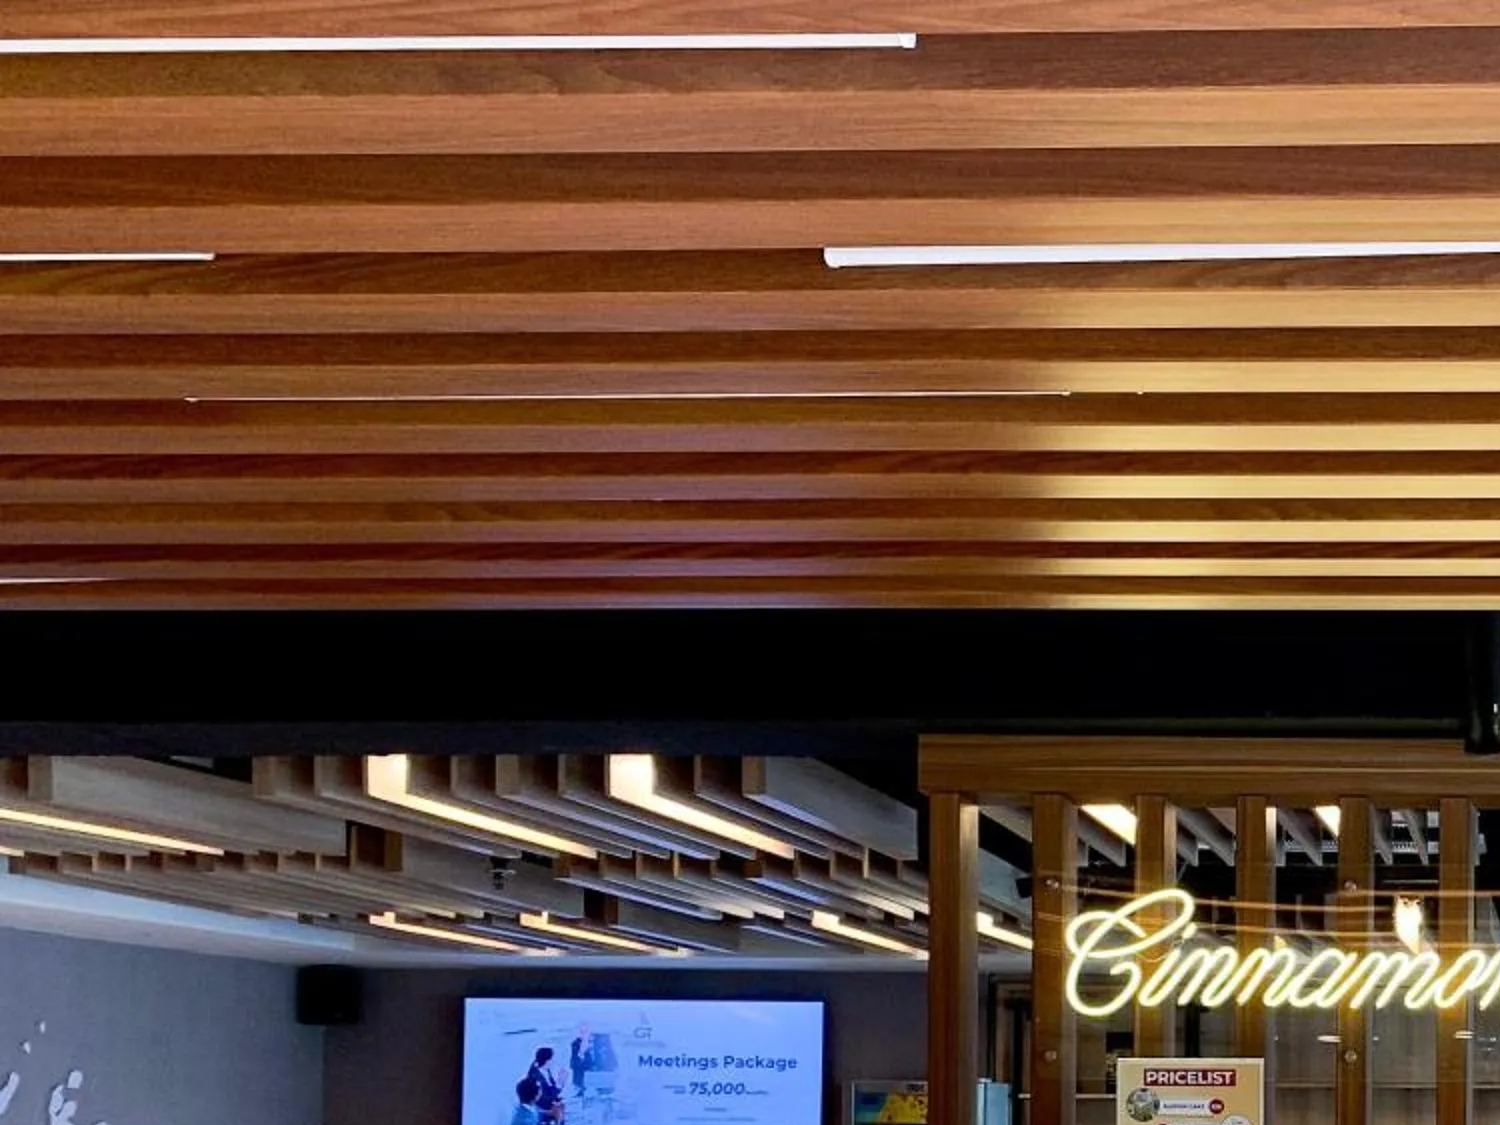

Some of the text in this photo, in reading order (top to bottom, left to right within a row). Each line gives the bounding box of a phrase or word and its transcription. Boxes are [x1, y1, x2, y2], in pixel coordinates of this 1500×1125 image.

[638, 1053, 798, 1072] Meetings Package
[1146, 1071, 1234, 1085] PRICELIST
[689, 1082, 746, 1097] 75,000
